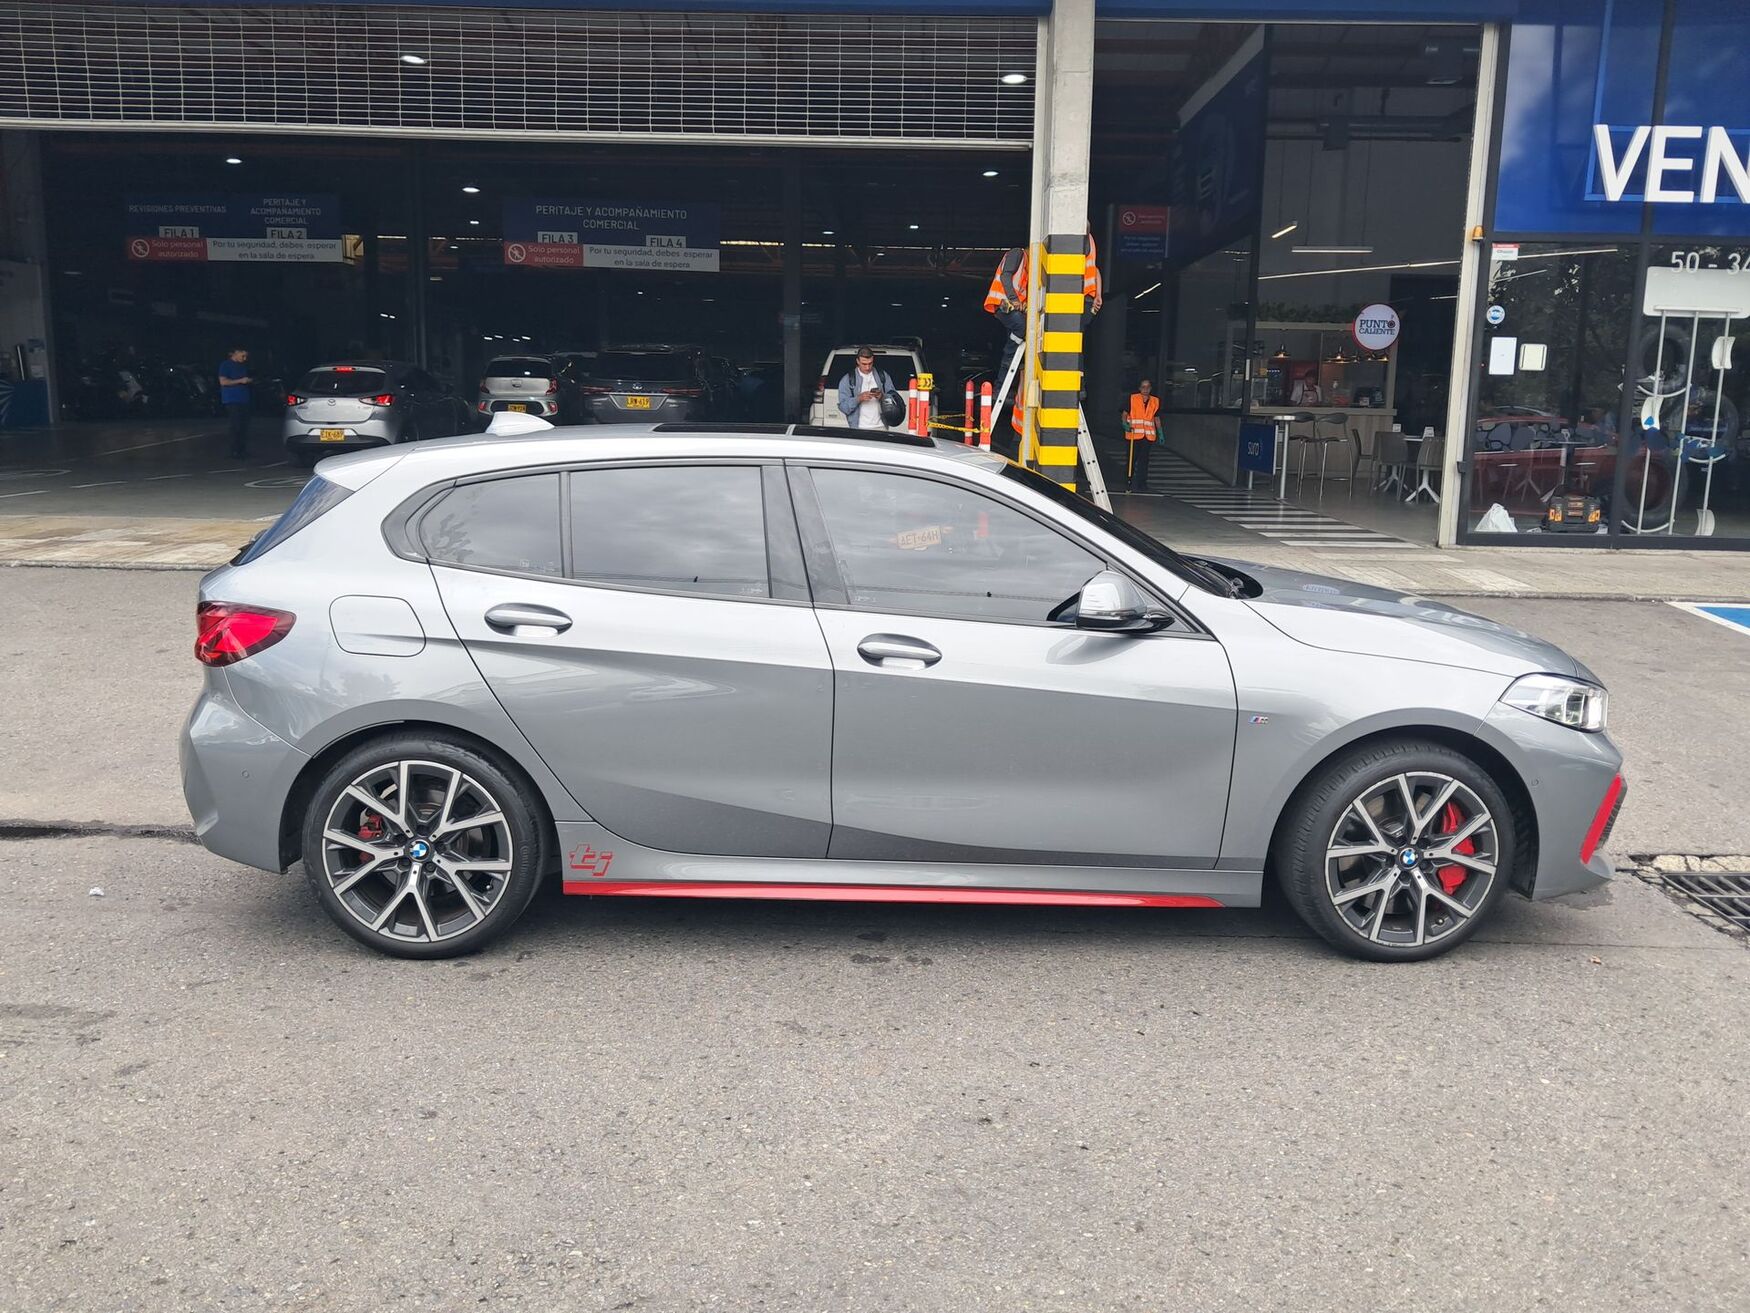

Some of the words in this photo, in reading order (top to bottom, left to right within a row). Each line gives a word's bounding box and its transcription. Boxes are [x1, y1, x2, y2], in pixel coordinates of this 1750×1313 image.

[1593, 124, 1750, 203] VEN
[263, 198, 300, 206] PERITAJE
[536, 205, 584, 216] PERITAJE
[586, 206, 593, 216] Y
[595, 206, 688, 220] ACOMPAÑAMIENTO
[264, 217, 309, 225] COMERCIAL
[583, 219, 640, 231] COMERCIAL
[164, 228, 187, 238] FILA
[271, 229, 294, 239] FILA
[542, 233, 565, 243] FILA
[170, 240, 203, 249] personal
[213, 240, 225, 248] Por
[279, 241, 303, 249] debes
[307, 242, 337, 251] esperar
[650, 237, 674, 248] FILA
[528, 245, 546, 253] Solo
[547, 246, 580, 255] personal
[604, 247, 612, 255] tu
[656, 249, 680, 257] debes
[683, 251, 713, 259] esperar
[534, 255, 574, 264] autorizado
[634, 259, 650, 267] sala
[664, 261, 690, 269] espera
[1671, 251, 1700, 274] 50
[1359, 319, 1396, 329] PUNTO
[1359, 328, 1396, 336] CALIENTE
